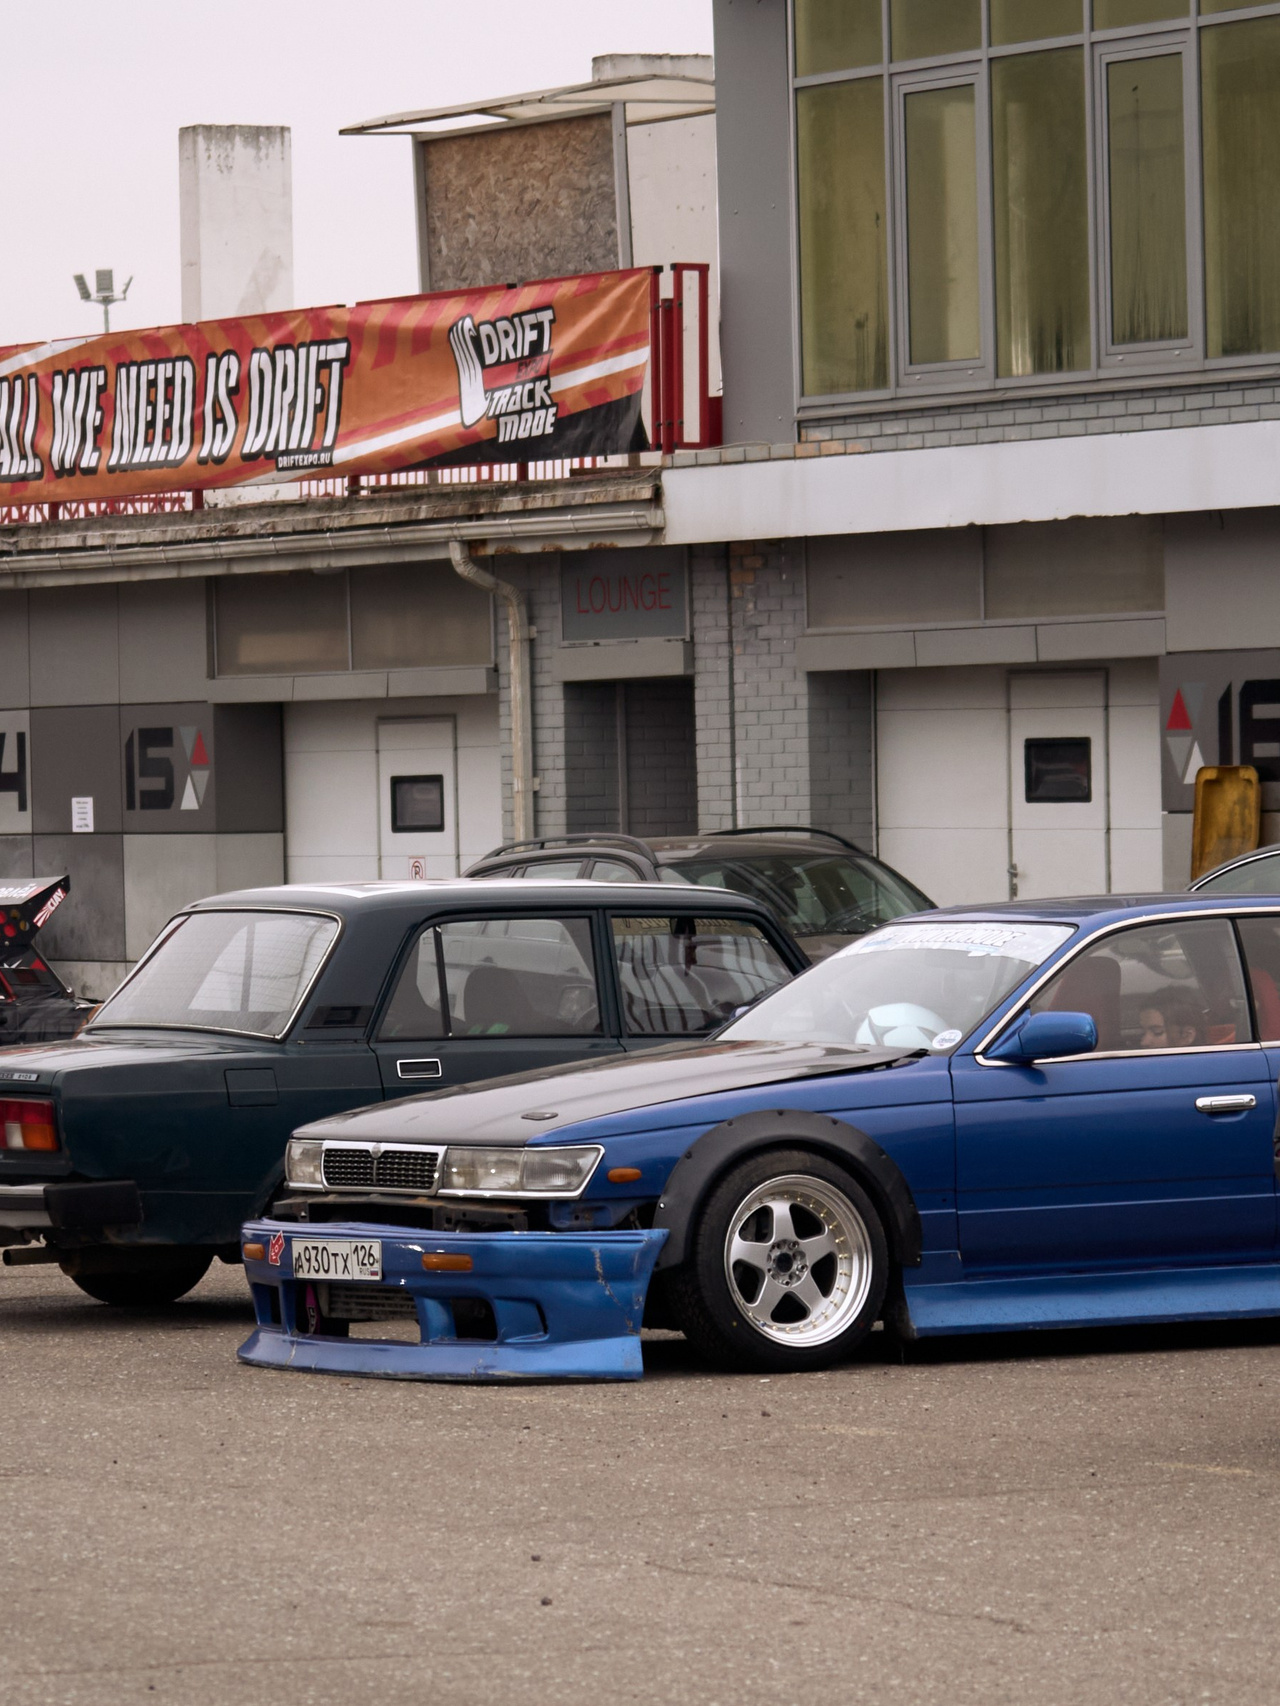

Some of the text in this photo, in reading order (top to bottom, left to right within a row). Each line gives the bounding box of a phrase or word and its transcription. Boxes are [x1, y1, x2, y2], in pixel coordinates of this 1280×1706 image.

[481, 308, 554, 365] DRIFT
[517, 357, 543, 378] EXPO
[53, 368, 105, 471] WE
[109, 359, 194, 465] NEED
[200, 353, 238, 457] IS
[243, 342, 348, 453] DRIFT
[489, 380, 551, 416] TRACK
[498, 407, 556, 443] MODE
[277, 453, 331, 468] DRIFTEXPO.RU
[575, 574, 673, 614] LOUNGE
[125, 727, 174, 811] 15
[353, 1244, 376, 1266] 126
